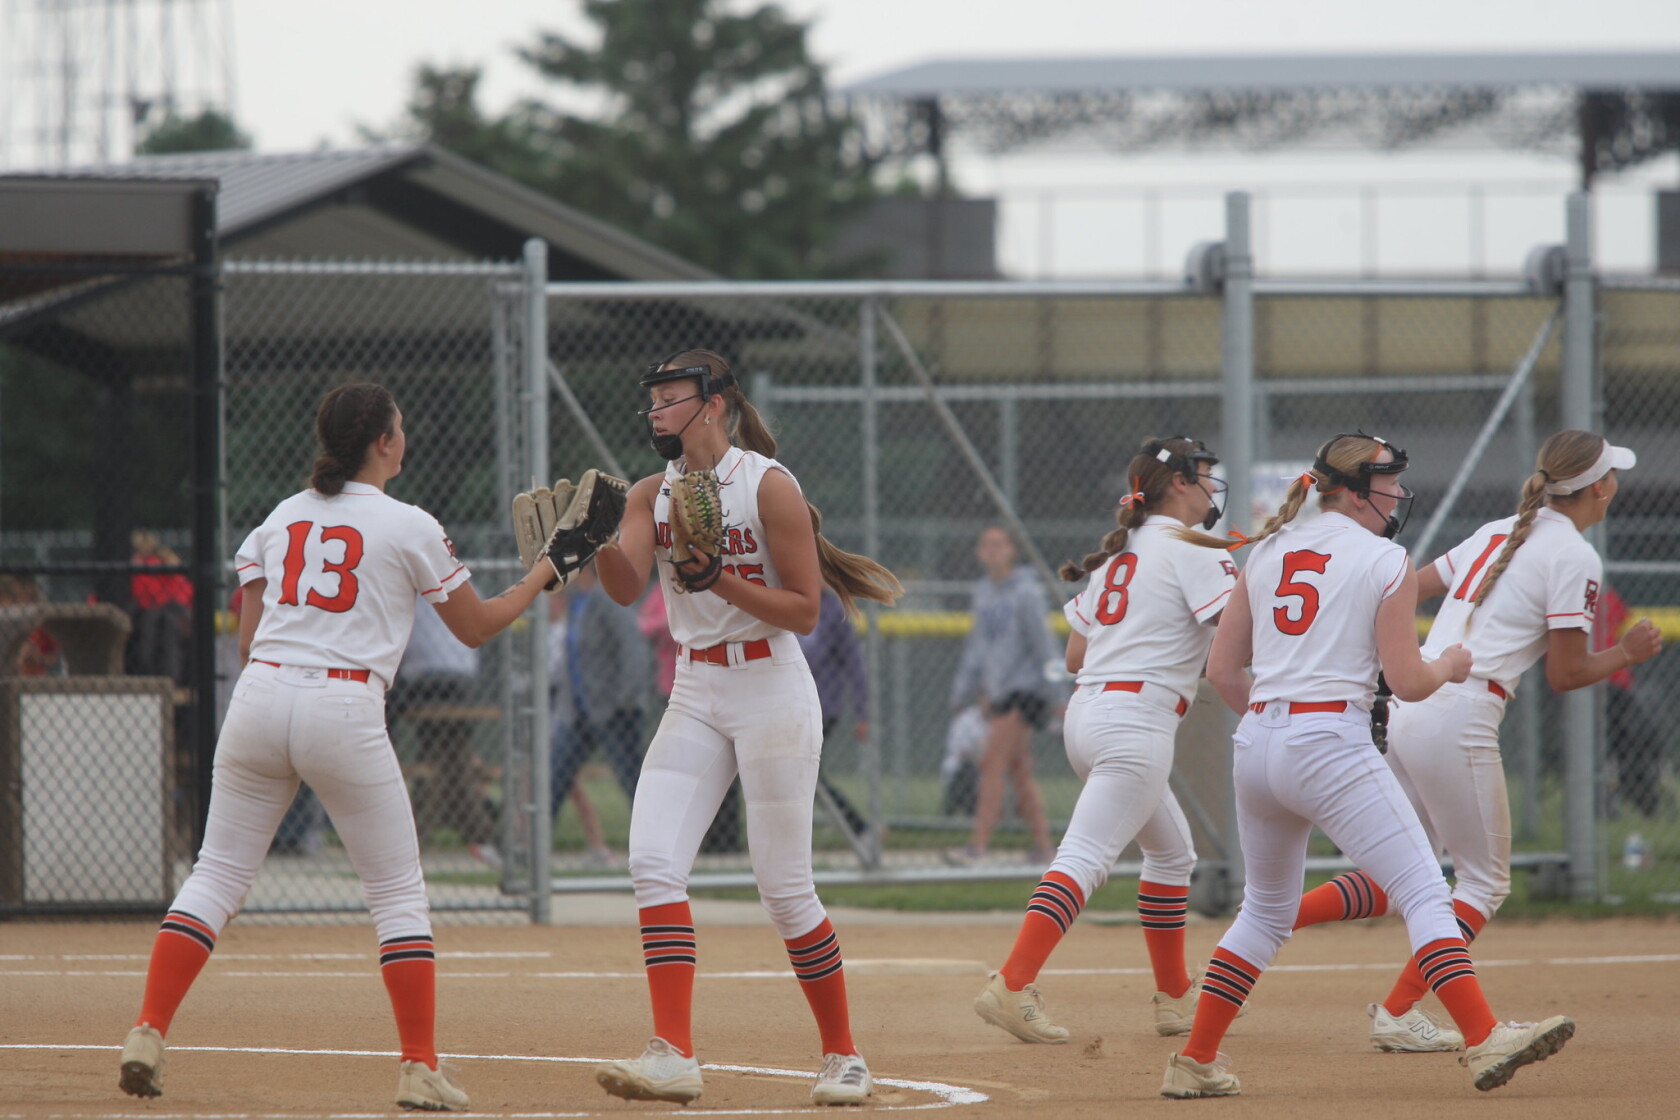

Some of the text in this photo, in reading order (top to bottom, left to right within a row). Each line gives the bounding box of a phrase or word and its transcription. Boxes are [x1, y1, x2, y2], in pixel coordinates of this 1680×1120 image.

[278, 521, 364, 613] 13
[1095, 552, 1138, 626] 8
[1273, 549, 1332, 636] 5
